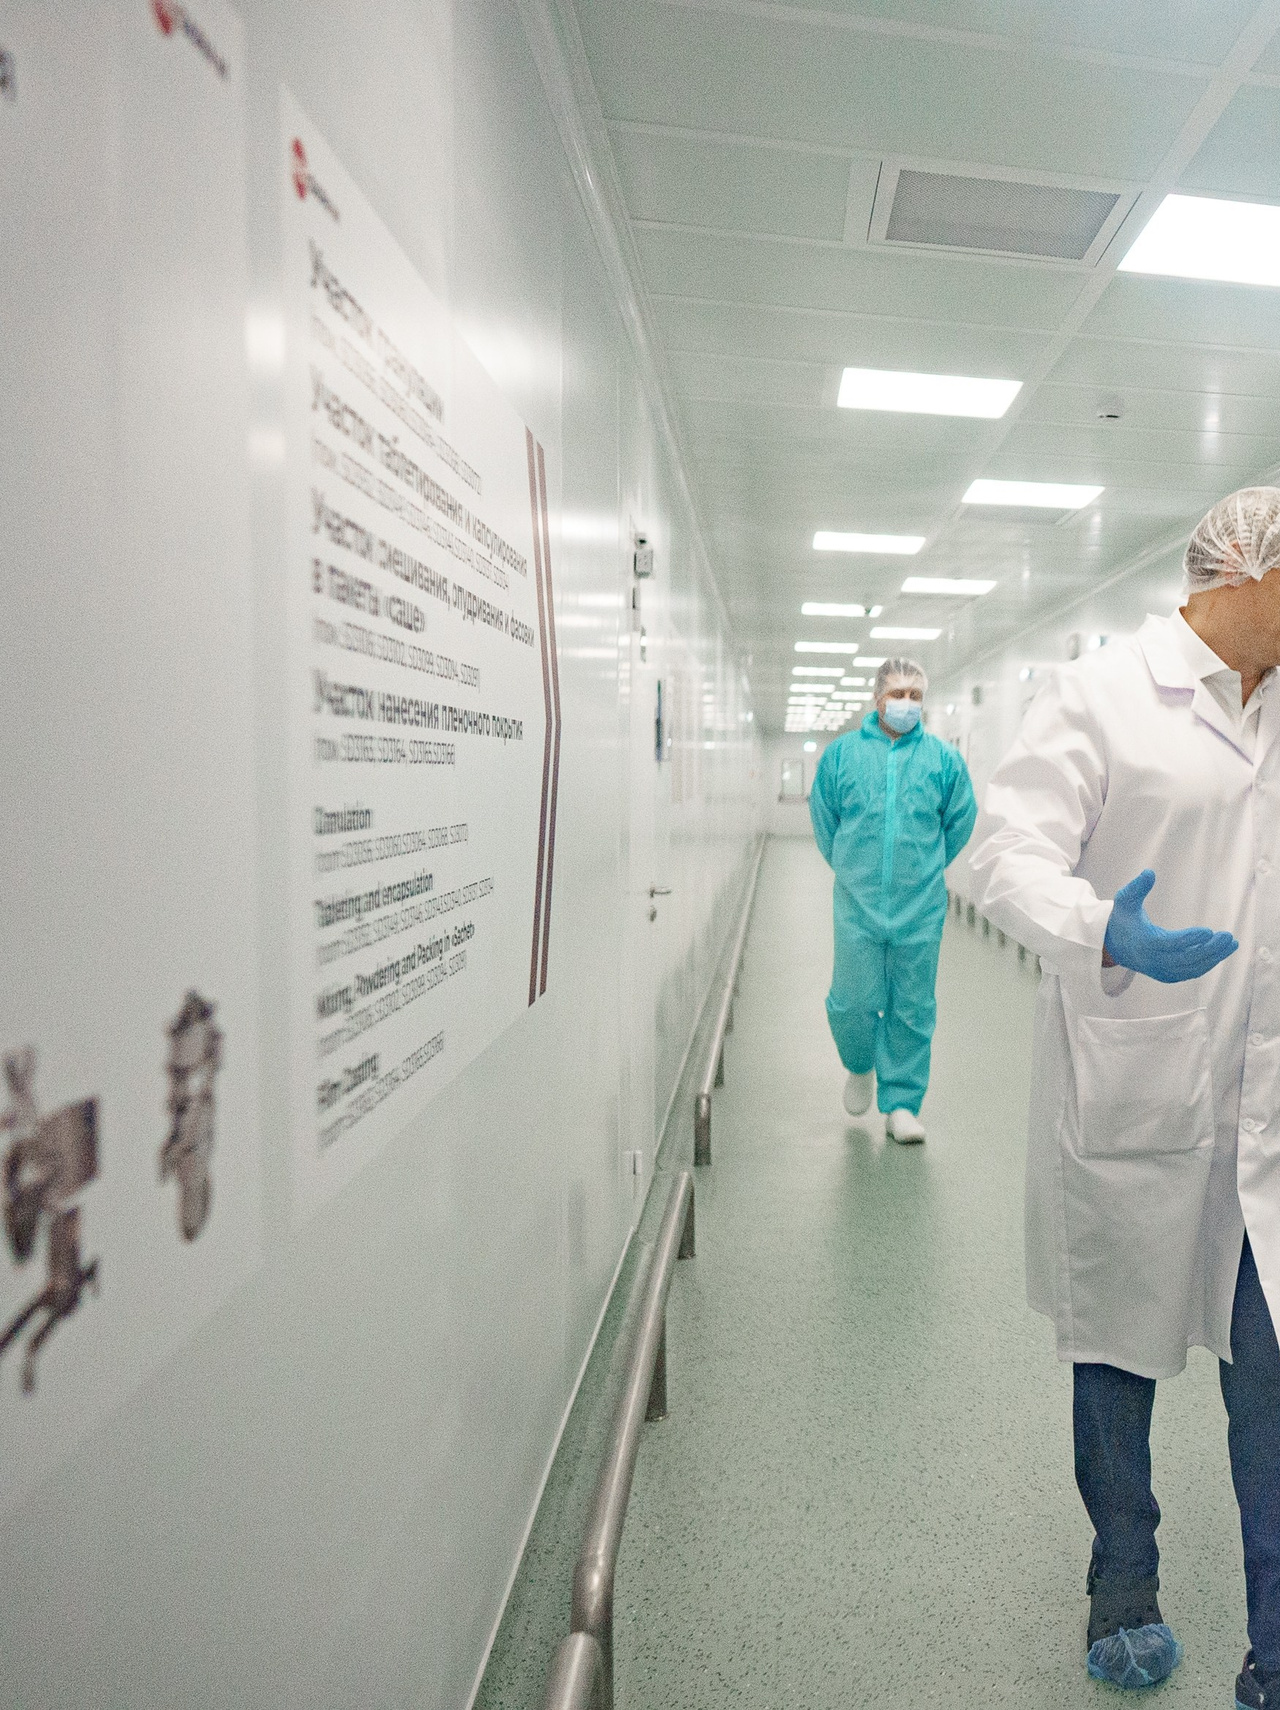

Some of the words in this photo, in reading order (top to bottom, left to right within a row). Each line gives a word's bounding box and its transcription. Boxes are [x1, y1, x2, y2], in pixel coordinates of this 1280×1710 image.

[472, 514, 527, 579] капсулирования
[378, 538, 450, 611] смешивания,
[452, 582, 504, 632] опудривания
[504, 612, 509, 635] и
[510, 609, 535, 648] фасовки
[382, 594, 426, 633] «саше»
[378, 690, 439, 730] нанесения
[441, 705, 491, 737] пленочного
[491, 715, 524, 745] покрытия
[381, 868, 433, 907] encapsulation
[354, 957, 400, 998] Powdering
[401, 945, 416, 975] and
[417, 935, 443, 967] Packing
[443, 929, 450, 952] in
